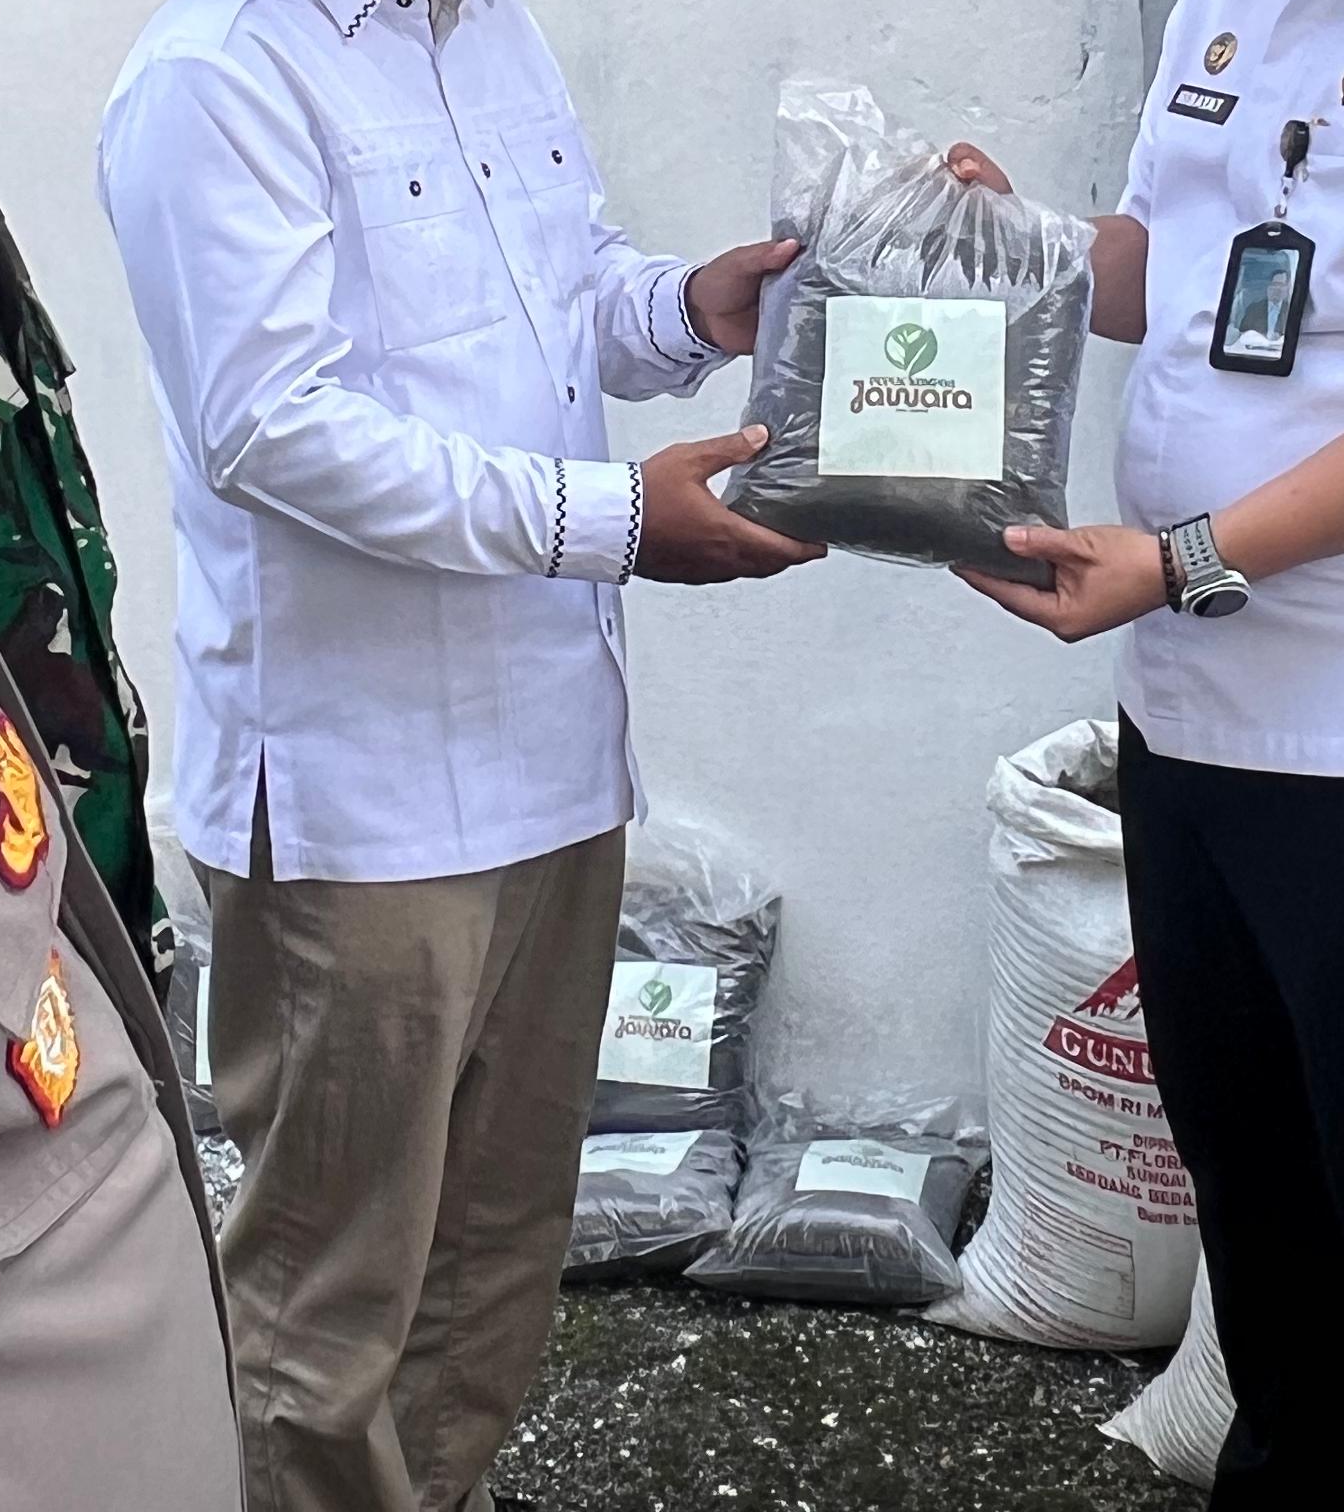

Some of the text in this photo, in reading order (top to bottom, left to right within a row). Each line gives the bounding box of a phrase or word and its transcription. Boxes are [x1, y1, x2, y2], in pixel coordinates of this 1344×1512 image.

[850, 380, 972, 414] Jawara
[1058, 1072, 1115, 1110] BPOM
[1121, 1098, 1141, 1115] RI
